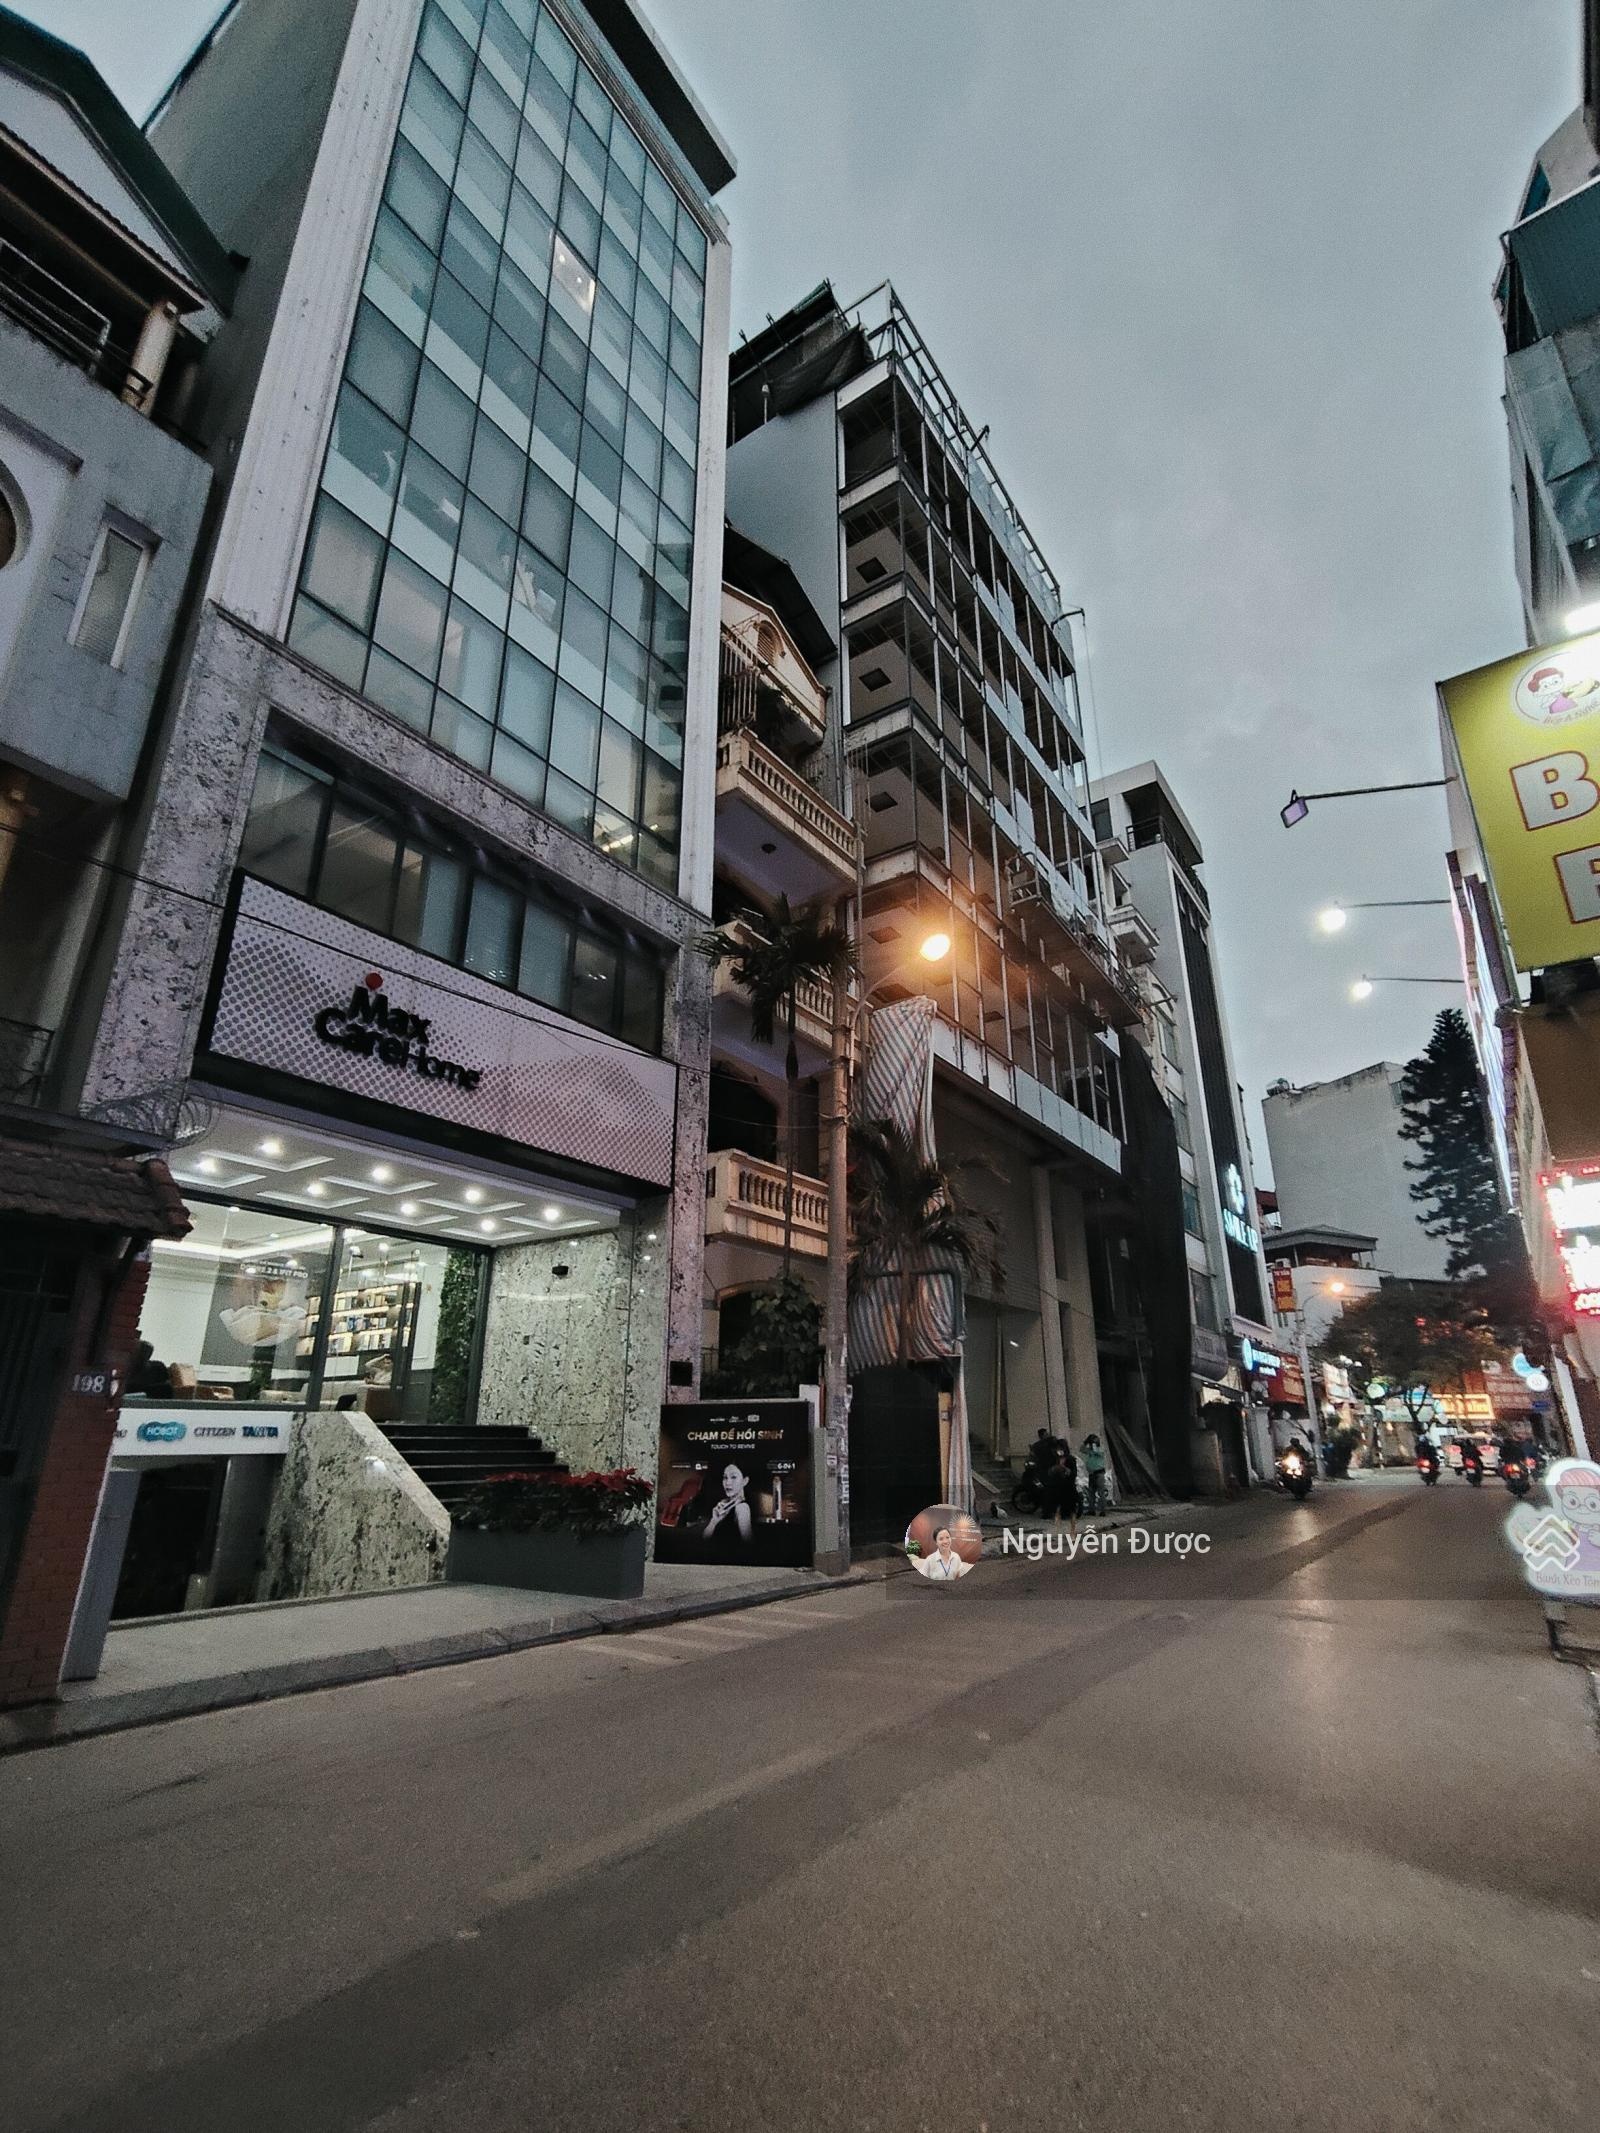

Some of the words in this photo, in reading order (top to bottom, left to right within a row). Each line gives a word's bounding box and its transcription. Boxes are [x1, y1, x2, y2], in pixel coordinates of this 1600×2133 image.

[350, 985, 432, 1047] Max
[72, 1374, 105, 1393] 198
[193, 1426, 236, 1438] CITIZEN
